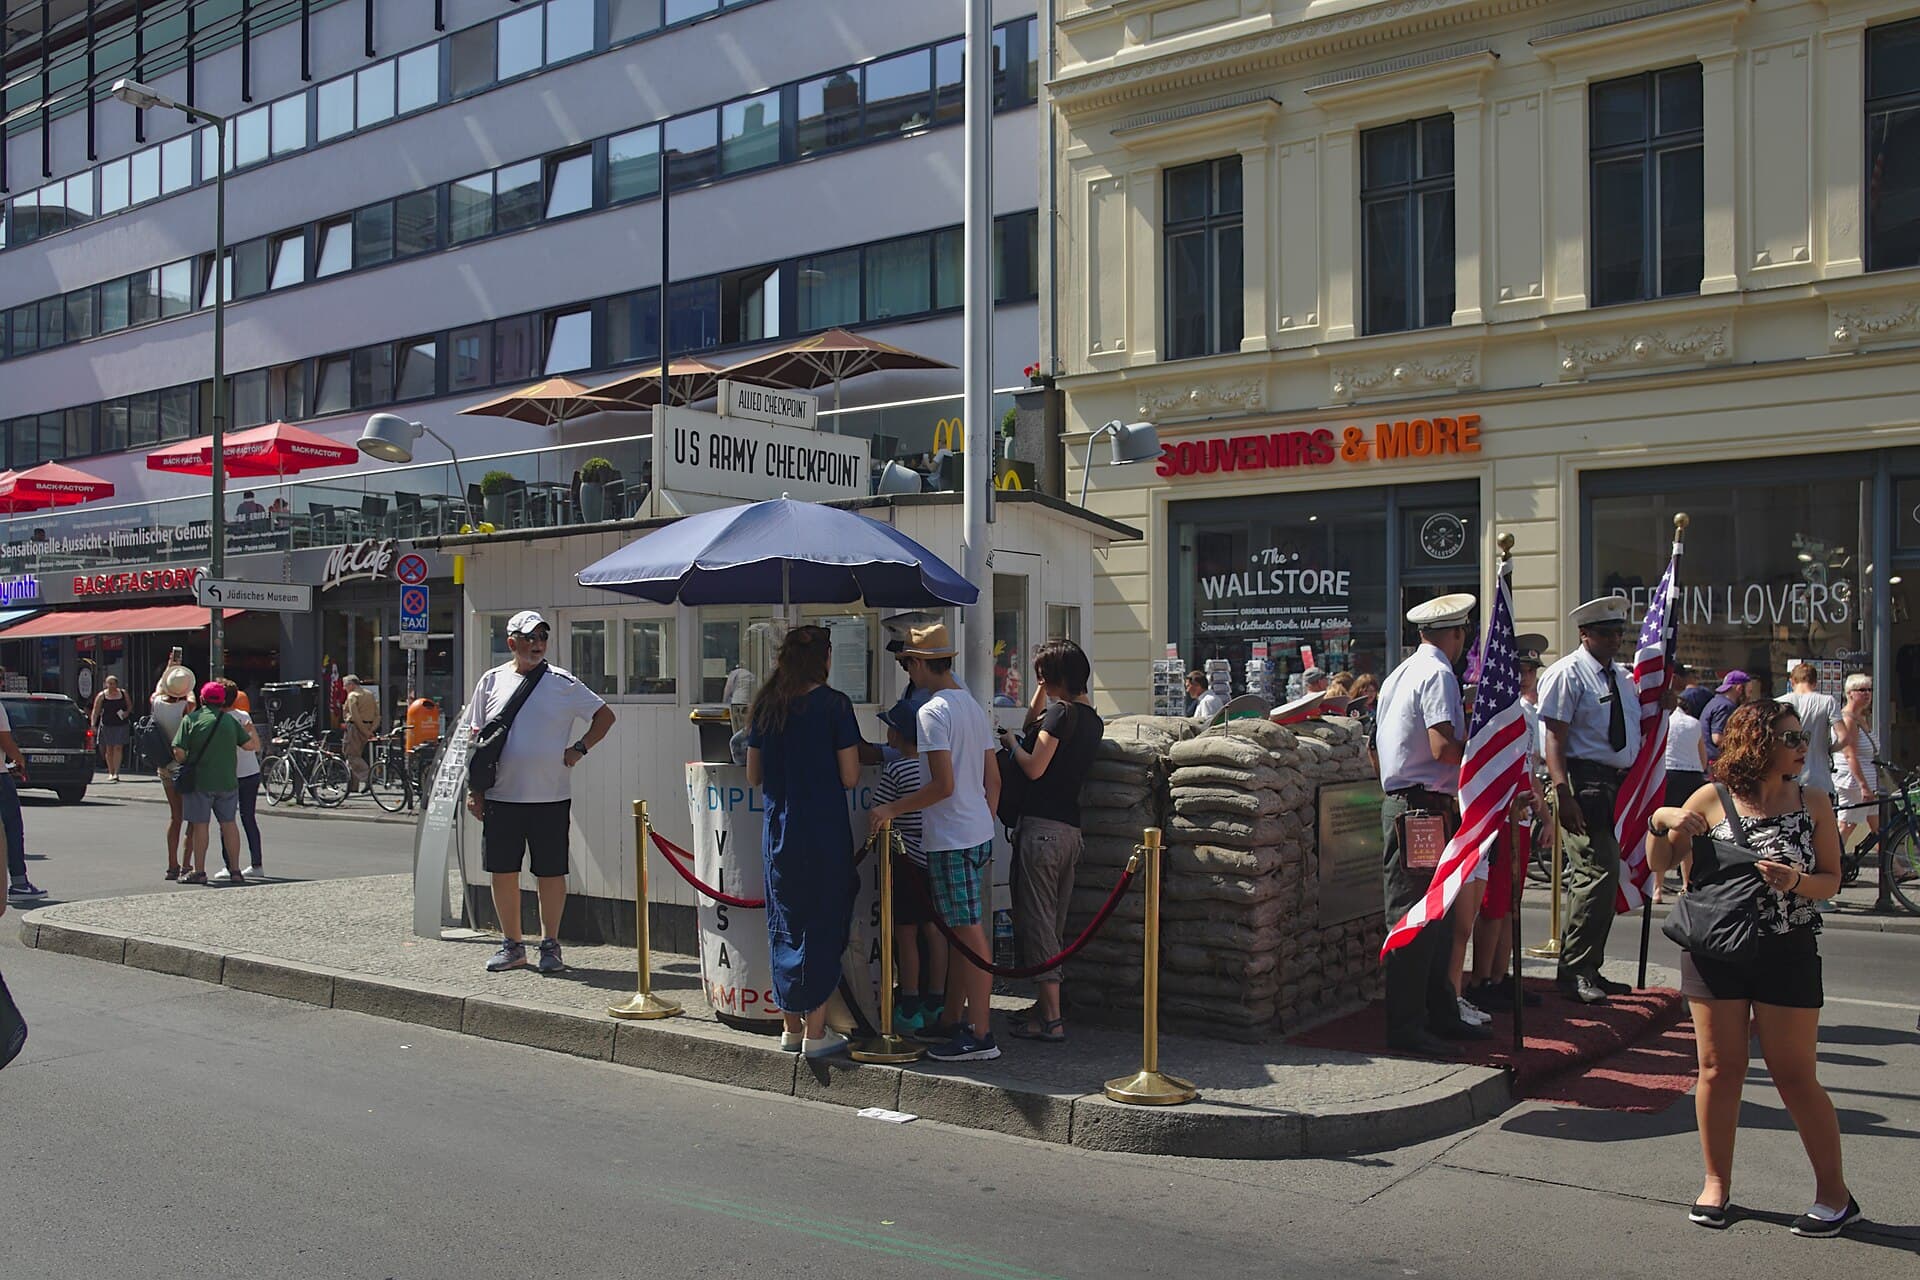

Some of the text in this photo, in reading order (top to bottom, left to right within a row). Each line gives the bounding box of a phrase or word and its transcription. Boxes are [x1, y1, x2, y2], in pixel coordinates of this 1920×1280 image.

[738, 389, 807, 419] ALLIED CHECKPOINT
[674, 428, 860, 488] US ARMY CHECKPOINT
[1156, 414, 1481, 477] SOUVENIRS & MORE
[1, 536, 60, 559] Sensationelle
[62, 532, 102, 552] Aussicht
[109, 523, 174, 548] Himmlischer
[1261, 547, 1287, 565] The
[322, 537, 393, 587] McCafé
[0, 574, 36, 606] yrinth
[226, 588, 299, 603] Jüdisches Museum
[1201, 569, 1350, 600] WALLSTORE
[1240, 606, 1308, 615] ORIGINAL BERLIN WALL
[1727, 582, 1849, 626] LOVERS
[1200, 621, 1235, 632] Souvenirs
[1240, 619, 1275, 631] Authentic
[1275, 618, 1299, 630] Berlin
[1300, 617, 1321, 630] Wall
